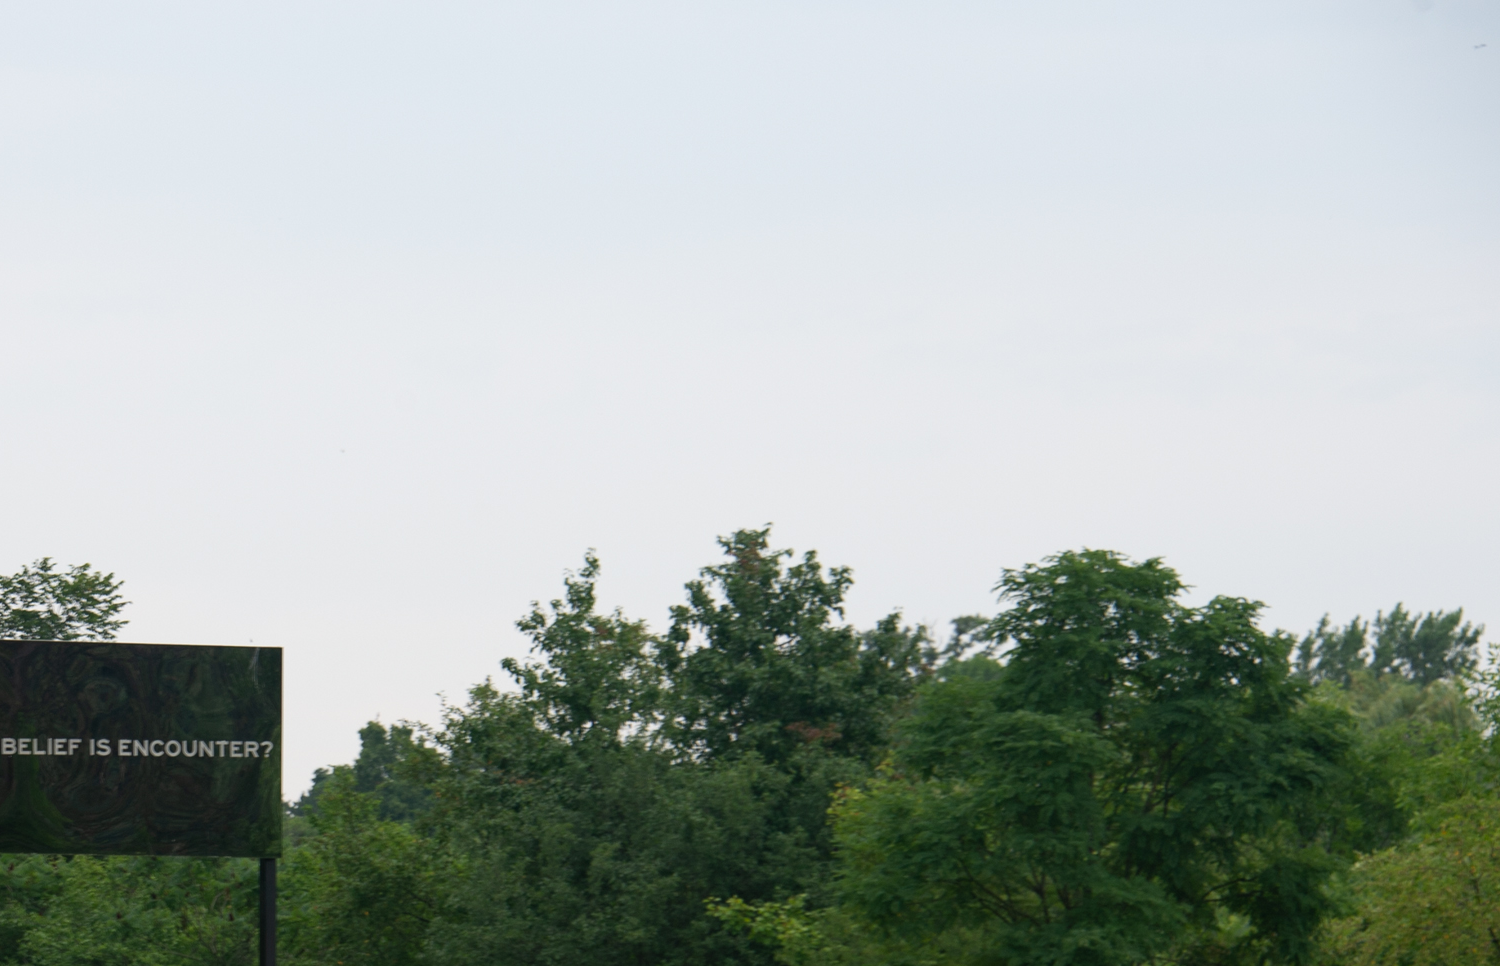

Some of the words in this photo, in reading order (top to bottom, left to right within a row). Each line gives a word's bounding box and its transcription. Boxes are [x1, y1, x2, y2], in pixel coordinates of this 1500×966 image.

[1, 737, 82, 756] BELIEF
[89, 738, 112, 756] IS
[118, 739, 274, 758] ENCOUNTER?
